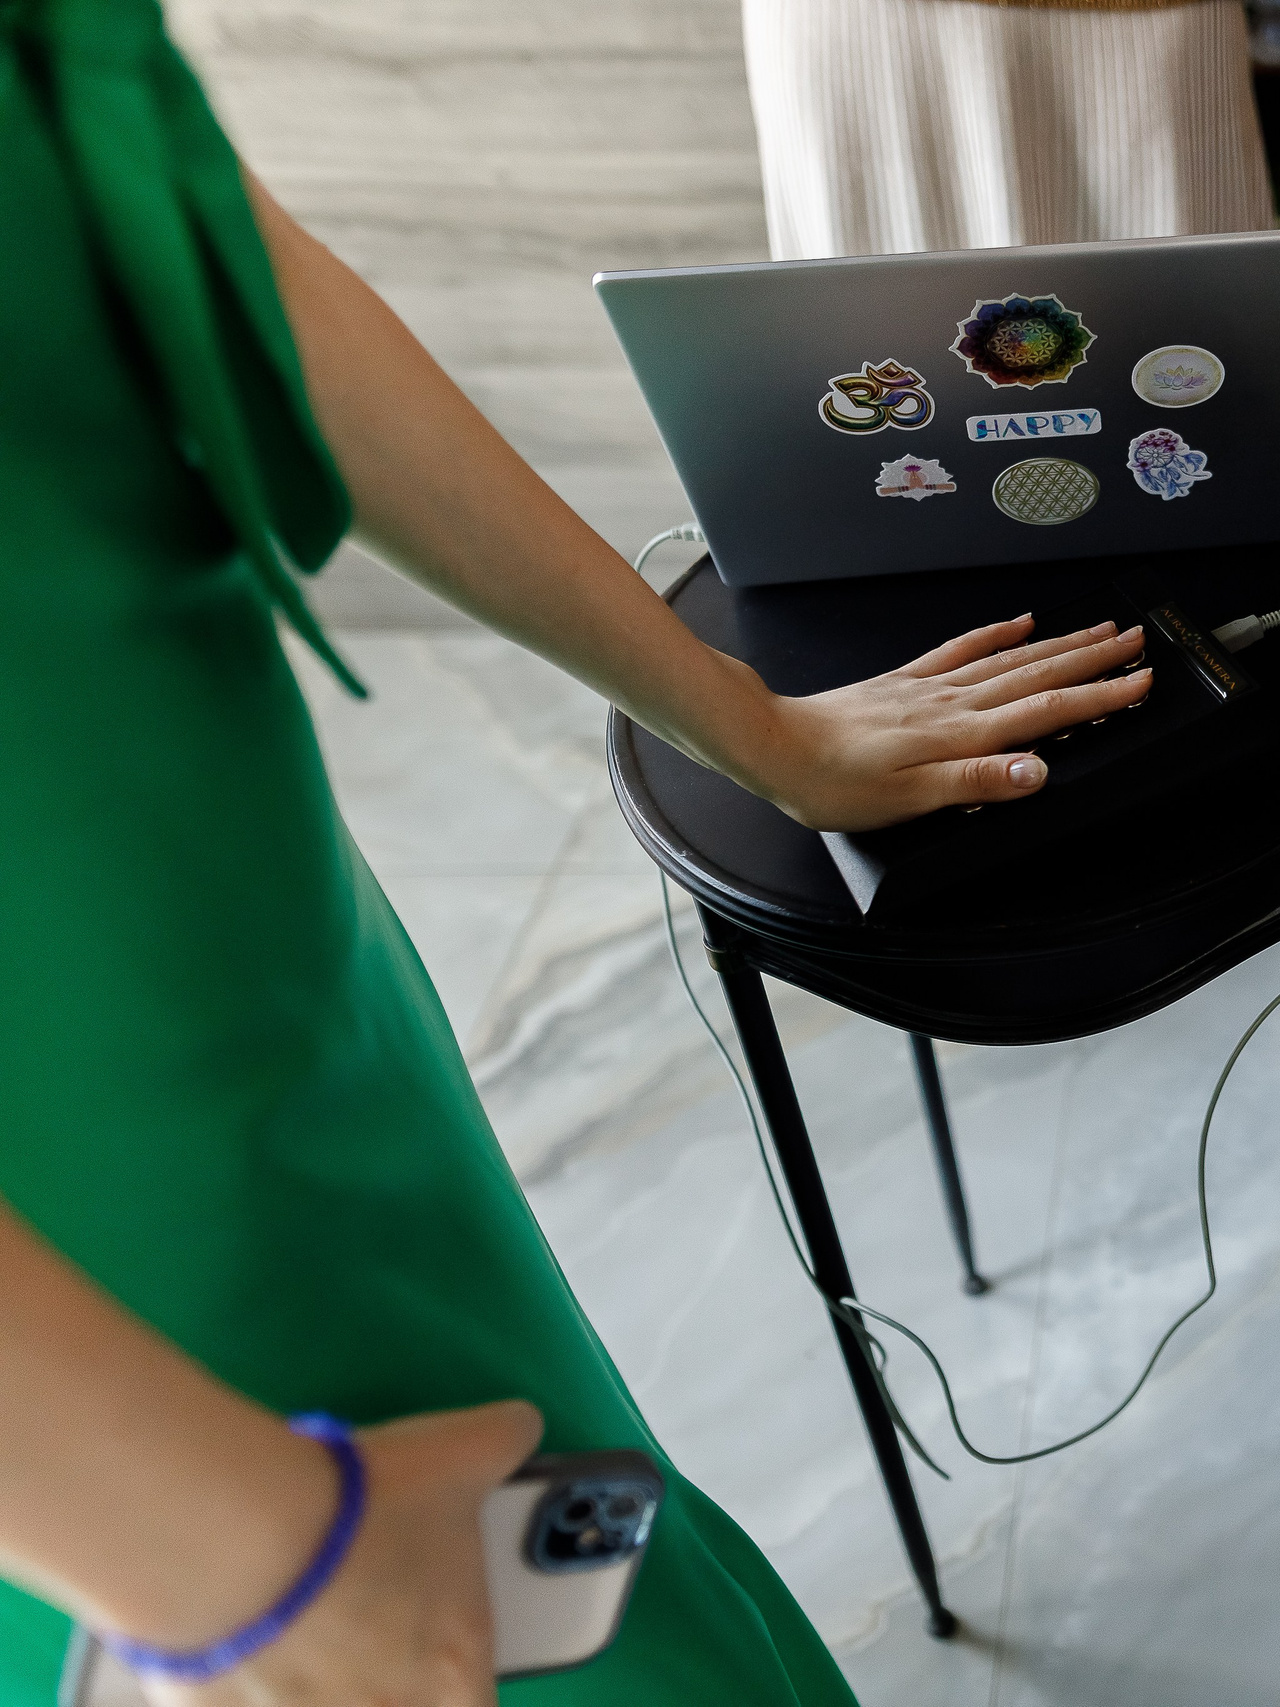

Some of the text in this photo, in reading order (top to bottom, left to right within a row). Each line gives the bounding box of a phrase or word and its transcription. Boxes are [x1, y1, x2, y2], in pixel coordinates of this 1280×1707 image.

[975, 411, 1098, 440] HAPPY
[1160, 609, 1237, 690] AURA CAMERA
